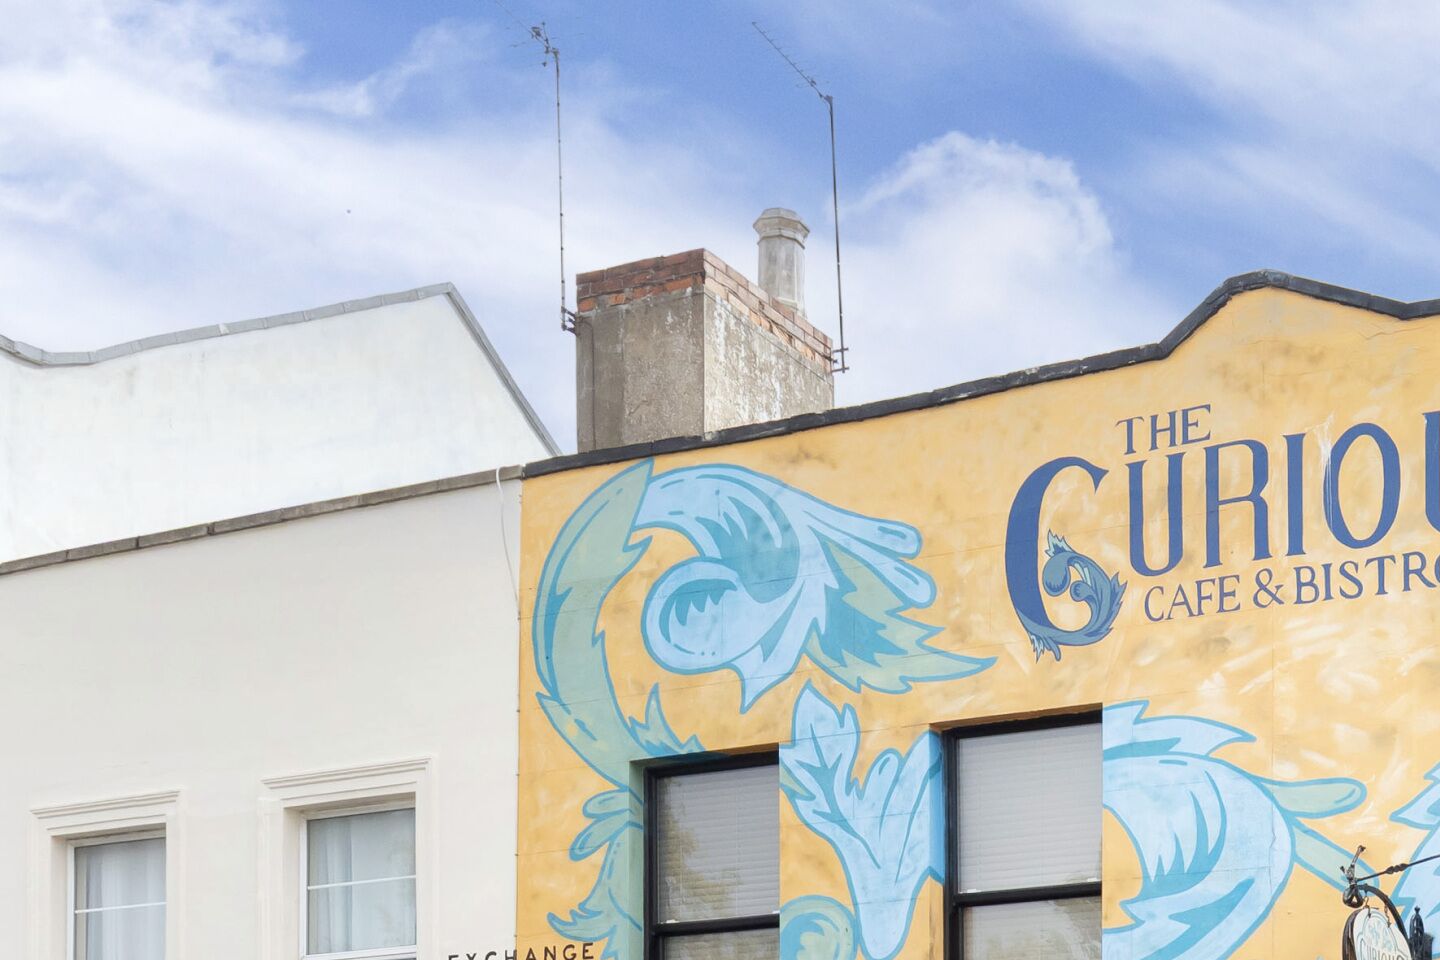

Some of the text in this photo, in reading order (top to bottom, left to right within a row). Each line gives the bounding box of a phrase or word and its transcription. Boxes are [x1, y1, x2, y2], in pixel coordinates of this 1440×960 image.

[1114, 403, 1213, 456] THE
[1142, 573, 1242, 622] CAFE
[1252, 568, 1286, 609] &
